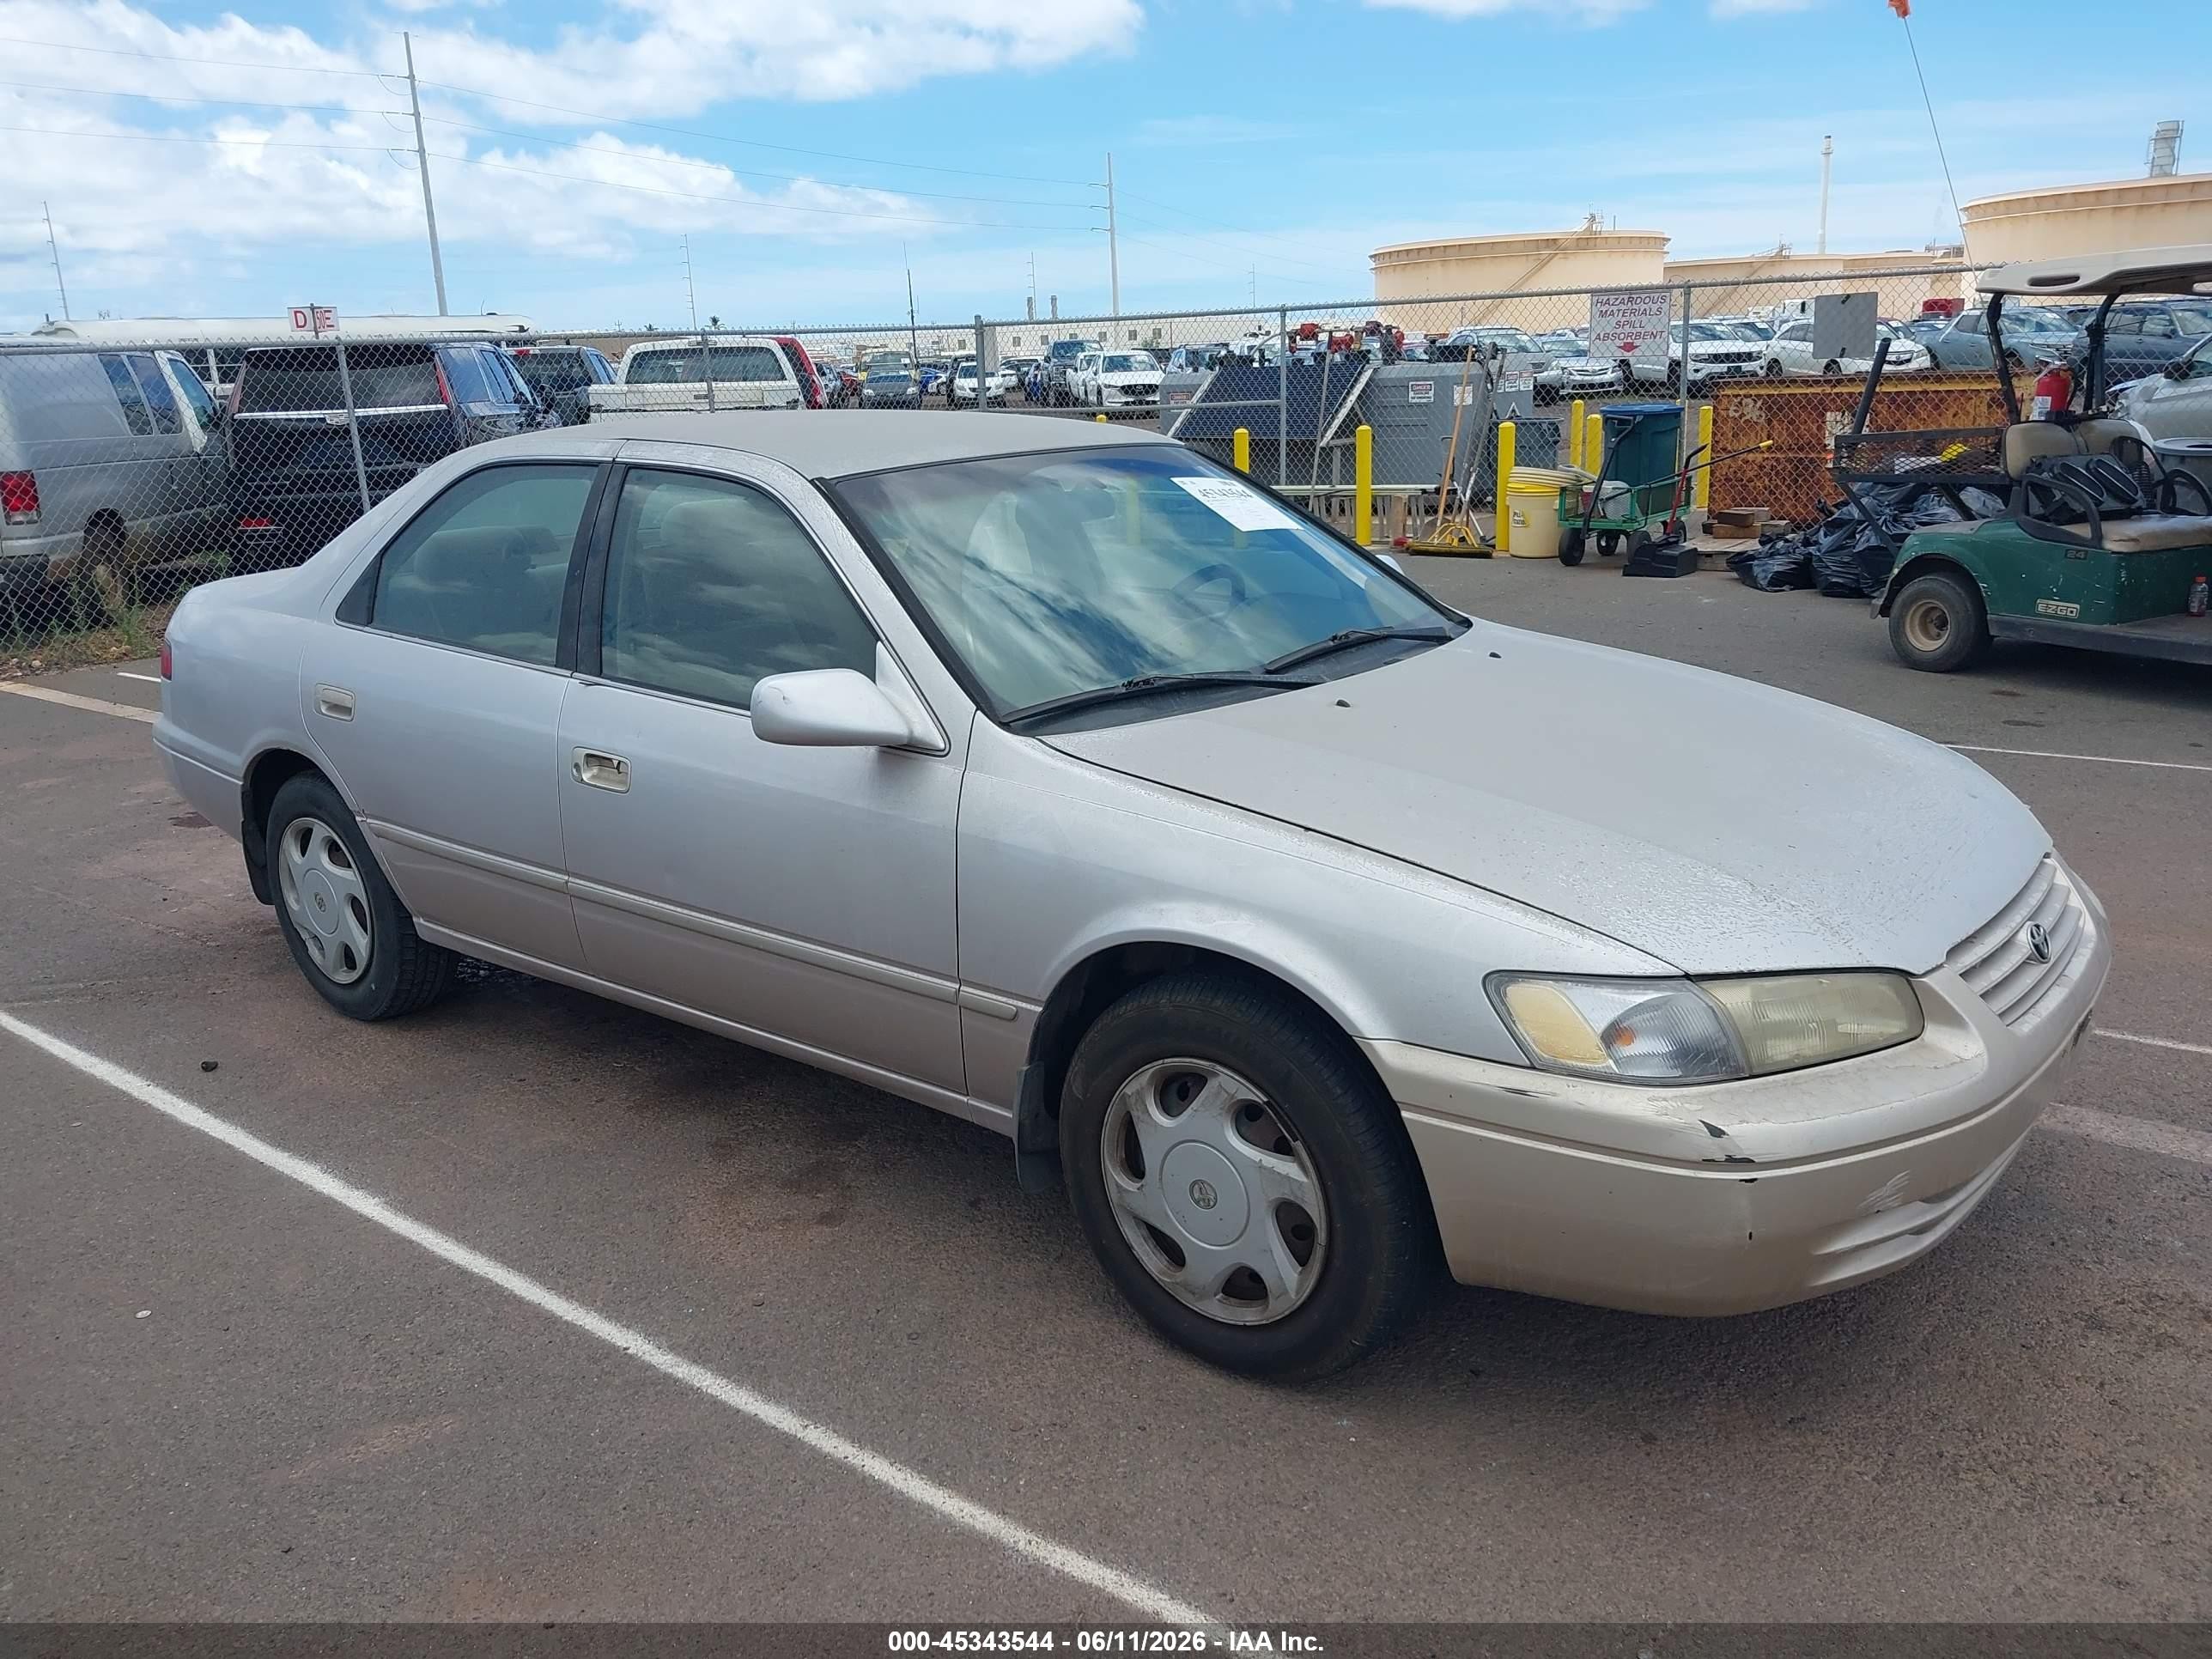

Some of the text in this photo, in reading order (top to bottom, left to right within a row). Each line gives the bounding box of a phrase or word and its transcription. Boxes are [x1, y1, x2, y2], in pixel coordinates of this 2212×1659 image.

[1595, 295, 1668, 307] HAZARDOUS
[1597, 307, 1664, 319] MATERIALS
[1613, 319, 1646, 330] SPILL
[1593, 331, 1667, 342] ABSORBENT
[2066, 550, 2086, 559] 24
